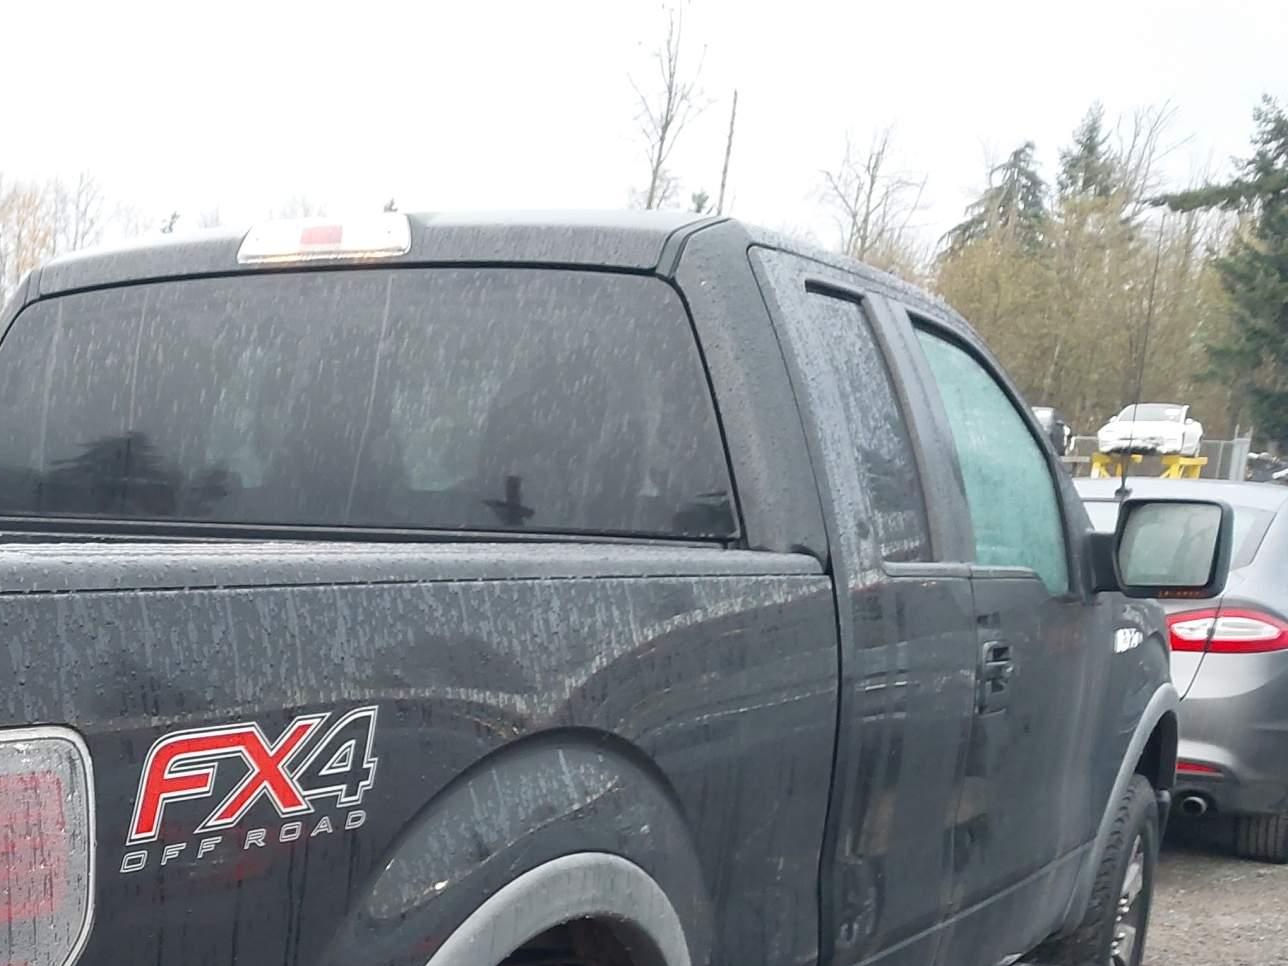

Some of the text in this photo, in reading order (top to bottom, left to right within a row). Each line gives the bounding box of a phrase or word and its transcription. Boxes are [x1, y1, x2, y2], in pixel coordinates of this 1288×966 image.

[126, 705, 378, 846] FX4
[120, 810, 367, 873] OFF ROAD
